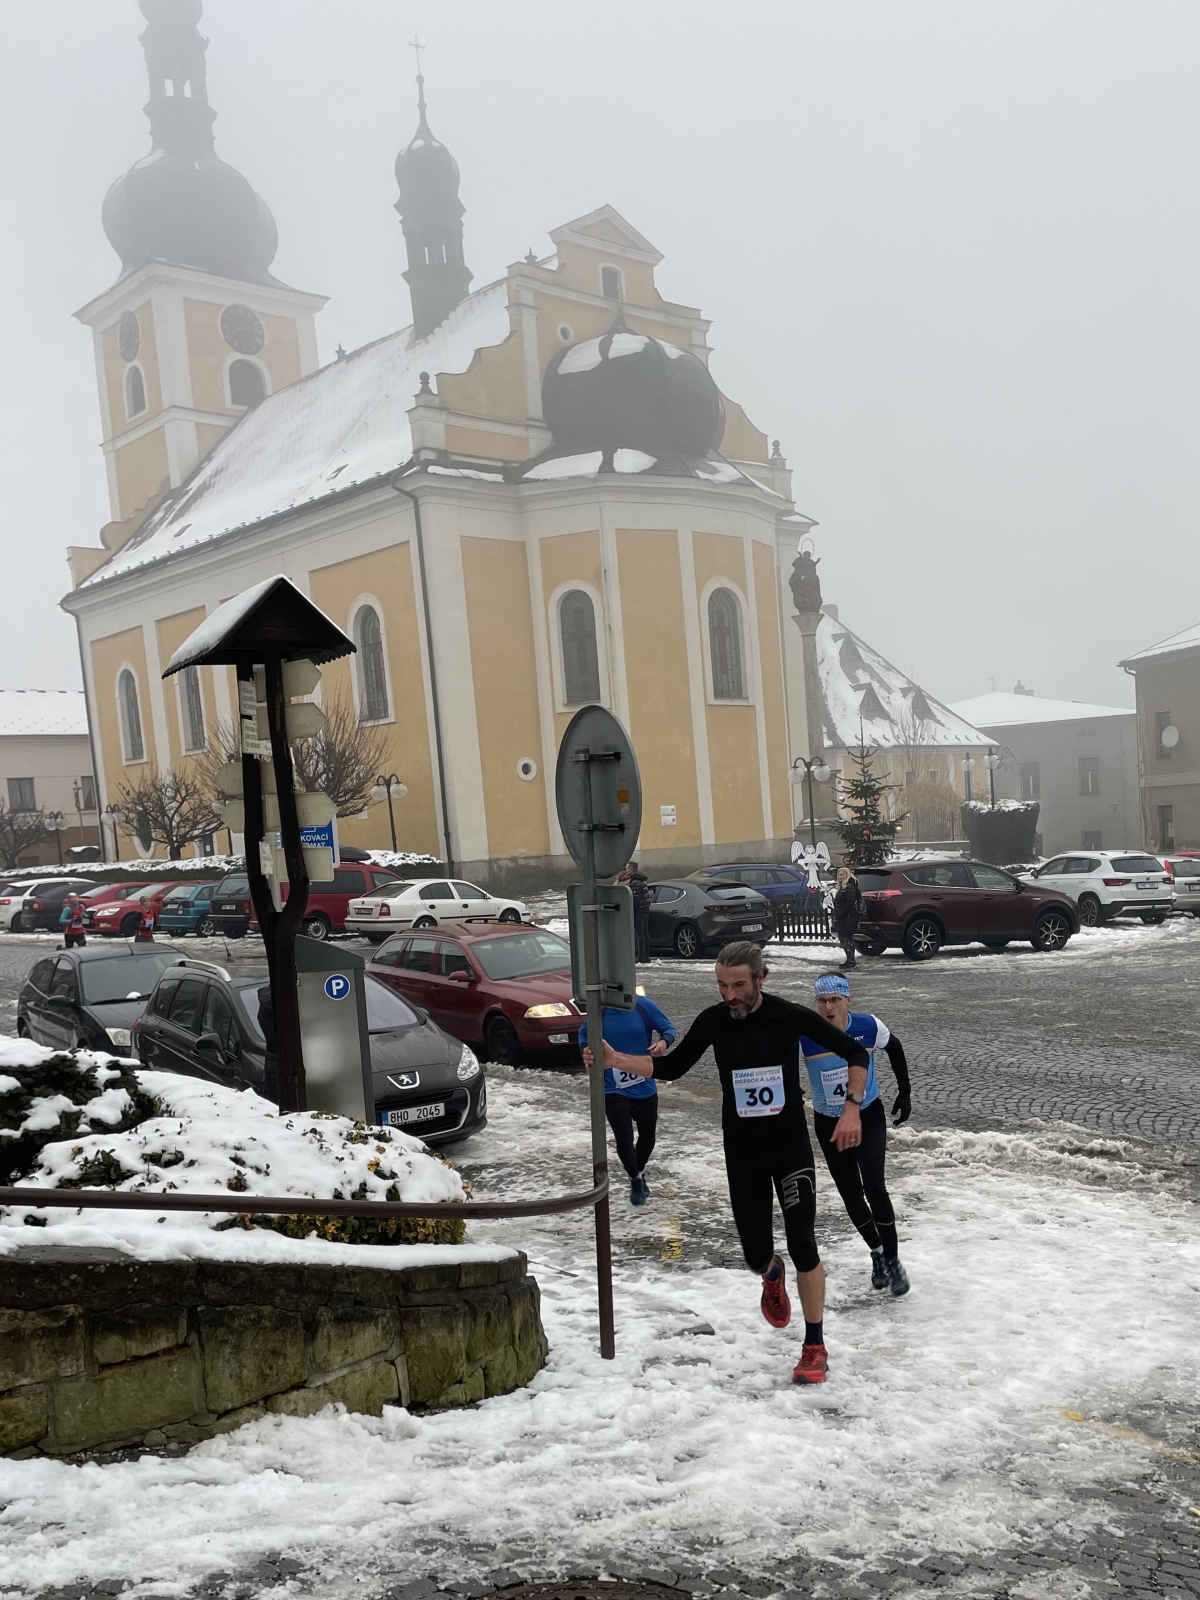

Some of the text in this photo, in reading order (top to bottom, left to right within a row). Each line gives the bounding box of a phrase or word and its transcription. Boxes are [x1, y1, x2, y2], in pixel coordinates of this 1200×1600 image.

[300, 833, 329, 842] KOVACÍ
[332, 979, 344, 995] P
[745, 1087, 774, 1107] 30
[833, 1083, 848, 1097] 4
[416, 1105, 440, 1119] 2045
